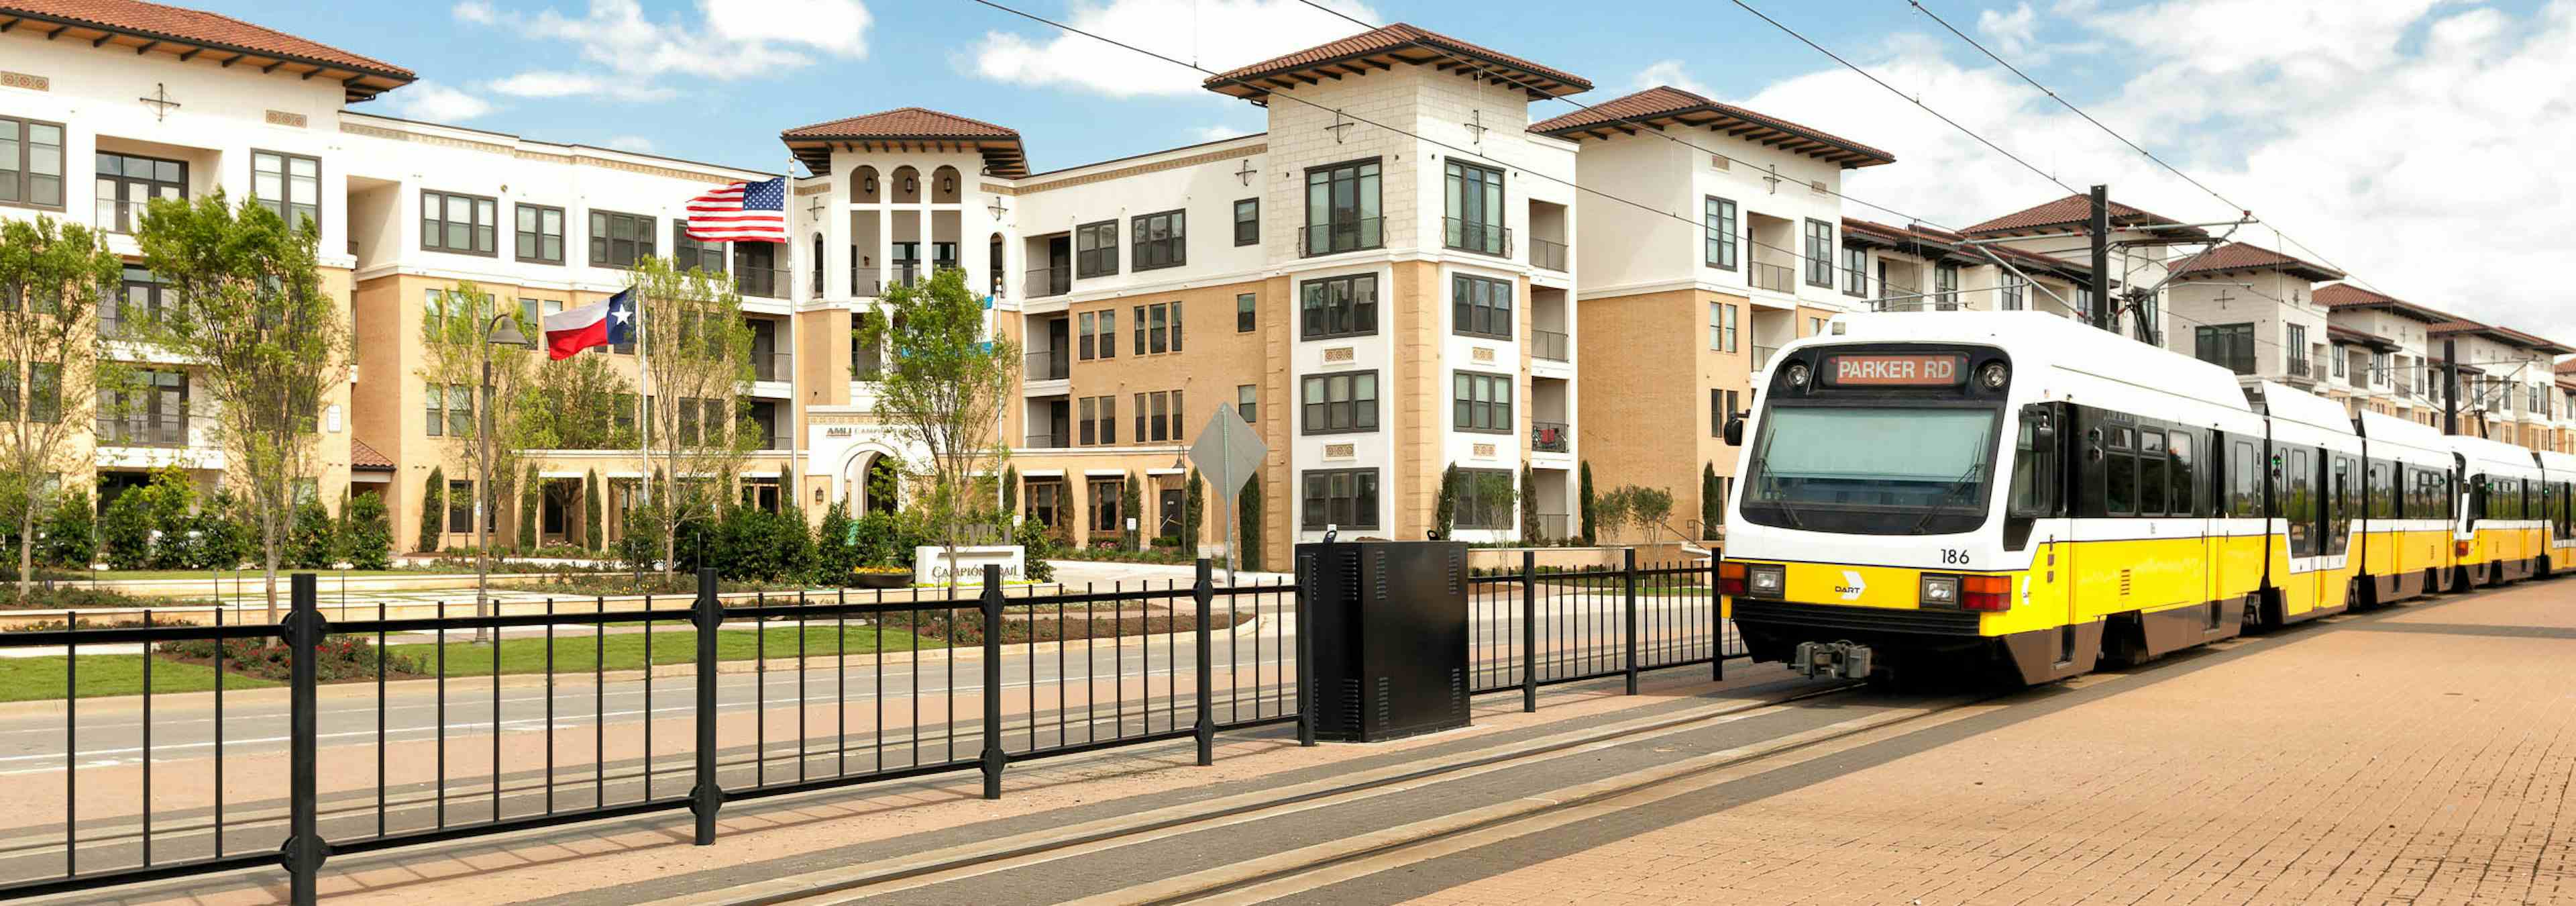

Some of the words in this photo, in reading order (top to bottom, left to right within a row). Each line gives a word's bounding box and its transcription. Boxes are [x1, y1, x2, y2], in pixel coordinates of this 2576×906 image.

[1839, 361, 1915, 378] PARKER
[1924, 361, 1952, 378] RD
[1941, 549, 1969, 564] 186
[999, 564, 1020, 576] RAIL
